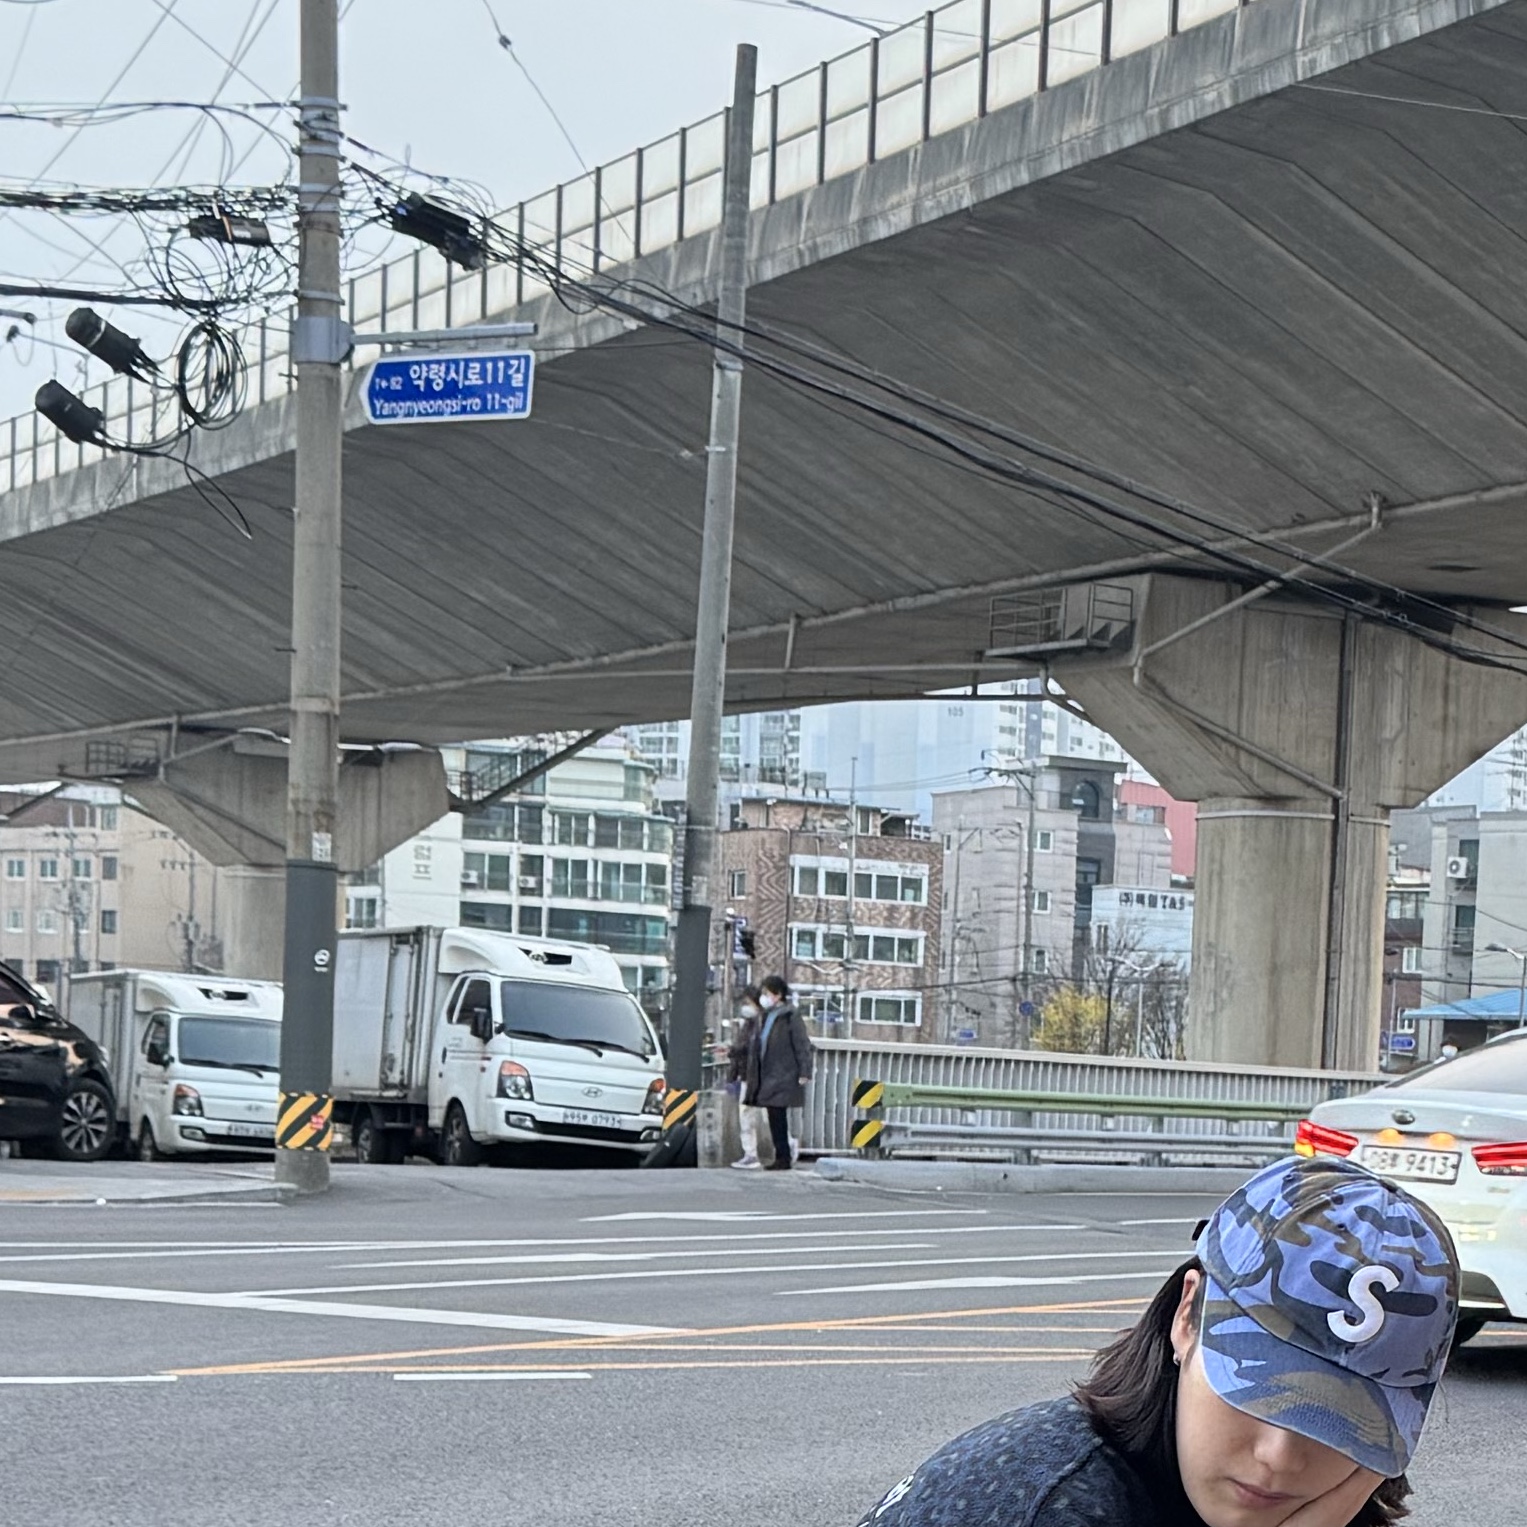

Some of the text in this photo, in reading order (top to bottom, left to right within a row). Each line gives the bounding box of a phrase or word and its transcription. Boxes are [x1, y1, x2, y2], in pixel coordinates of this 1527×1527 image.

[409, 358, 525, 391] 약령시로11길
[373, 393, 524, 418] Yangnyeongsi-ro 11-gil
[1327, 1265, 1399, 1342] S
